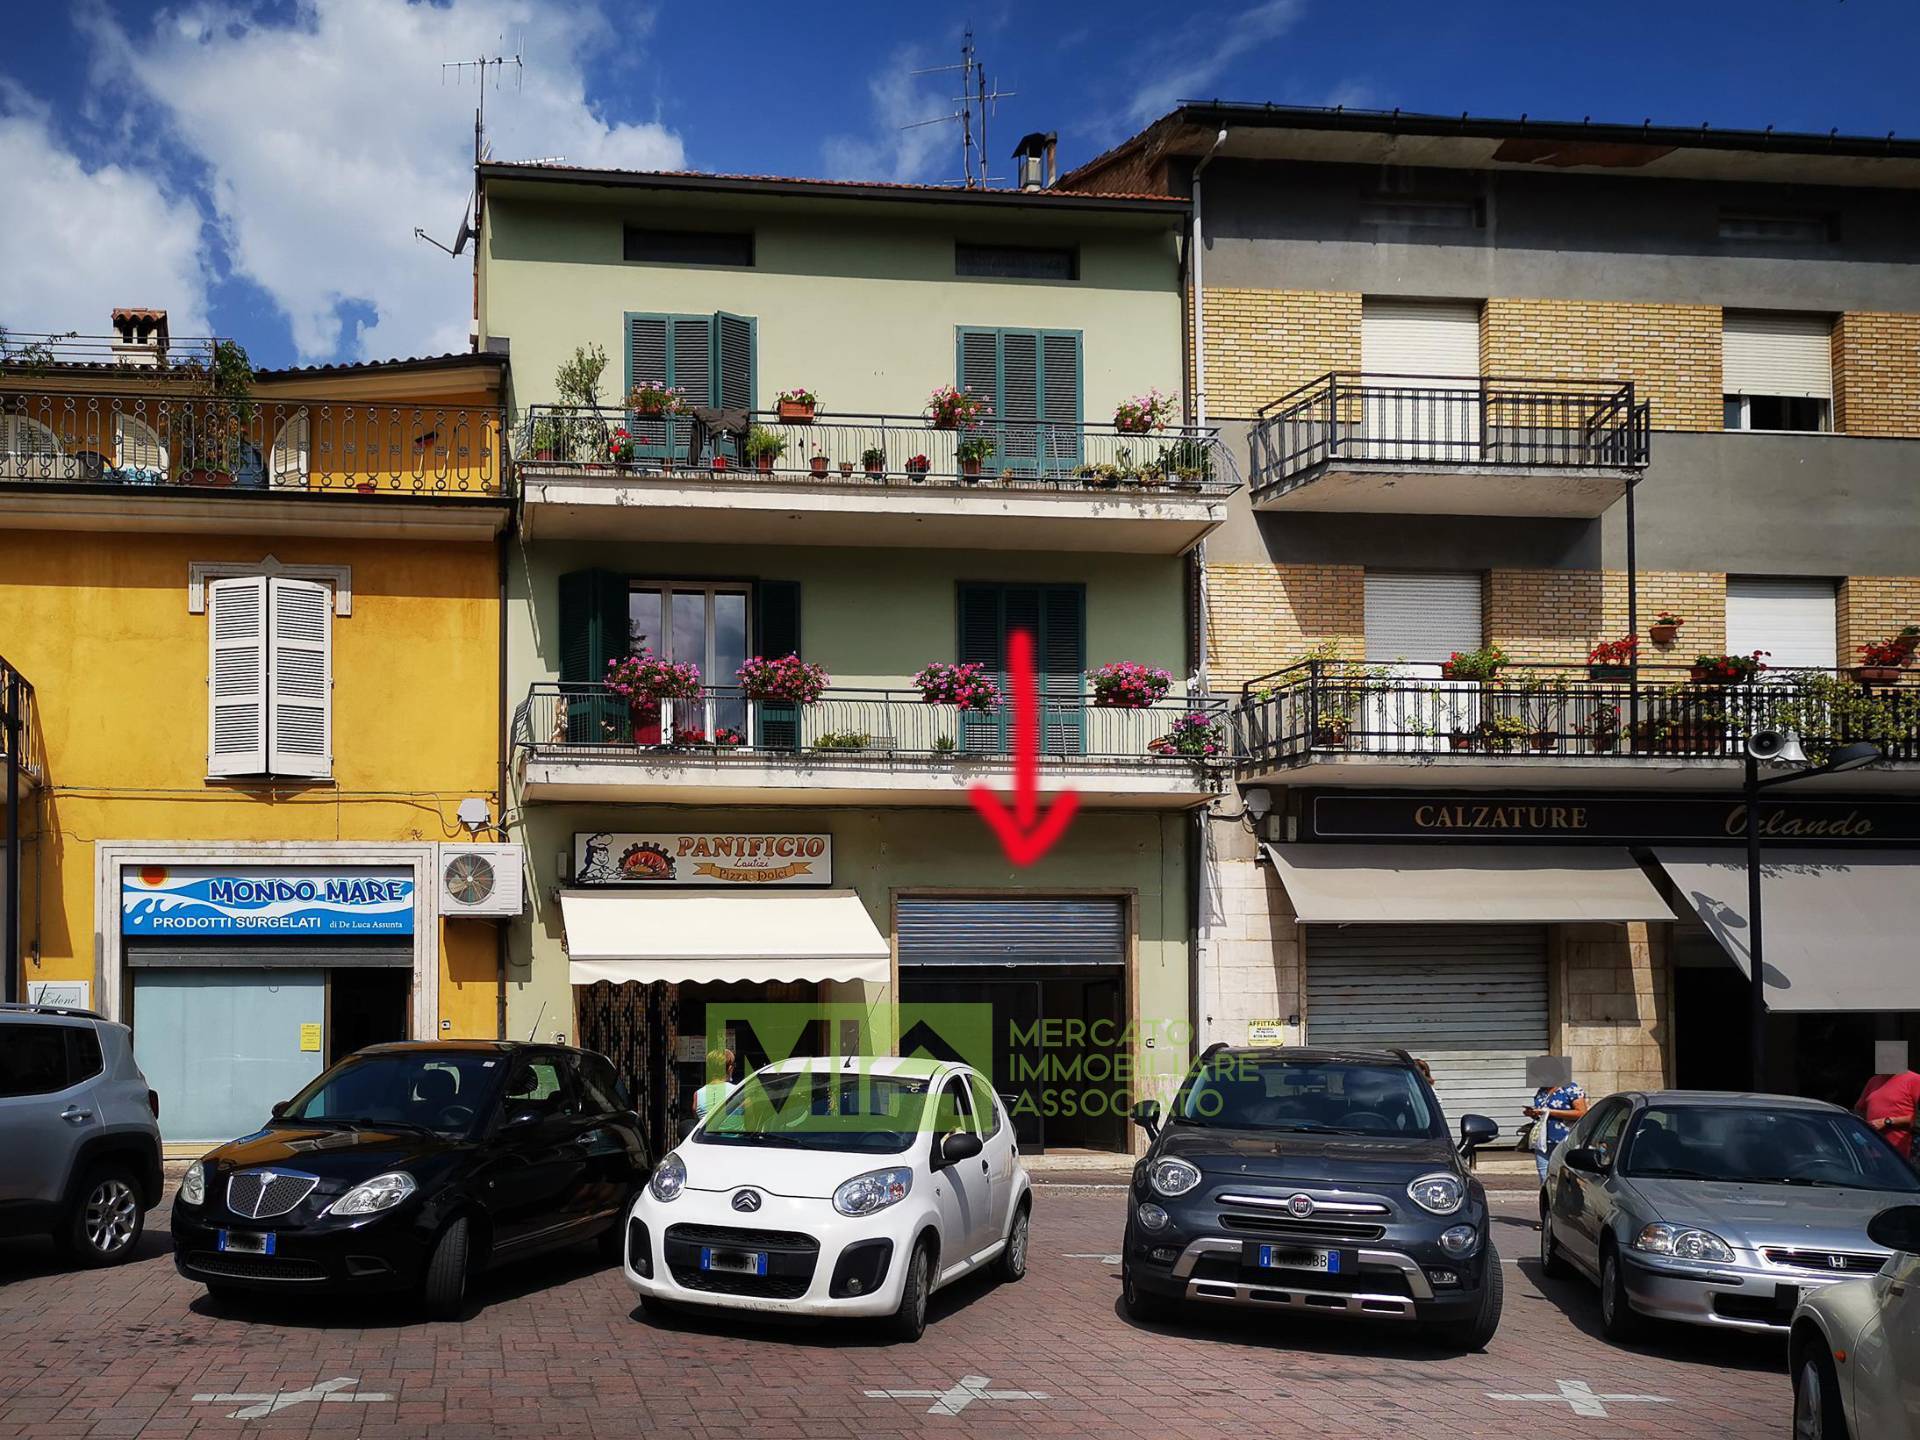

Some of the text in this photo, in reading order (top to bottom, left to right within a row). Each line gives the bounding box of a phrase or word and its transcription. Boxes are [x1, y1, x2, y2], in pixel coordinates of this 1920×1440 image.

[1414, 805, 1588, 829] CALZATURE
[676, 836, 825, 857] PANIFICIO
[720, 868, 748, 881] Pizza
[210, 879, 404, 904] MONDO MARE
[153, 917, 231, 928] PRODOTTI
[236, 917, 321, 928] SURGELATI
